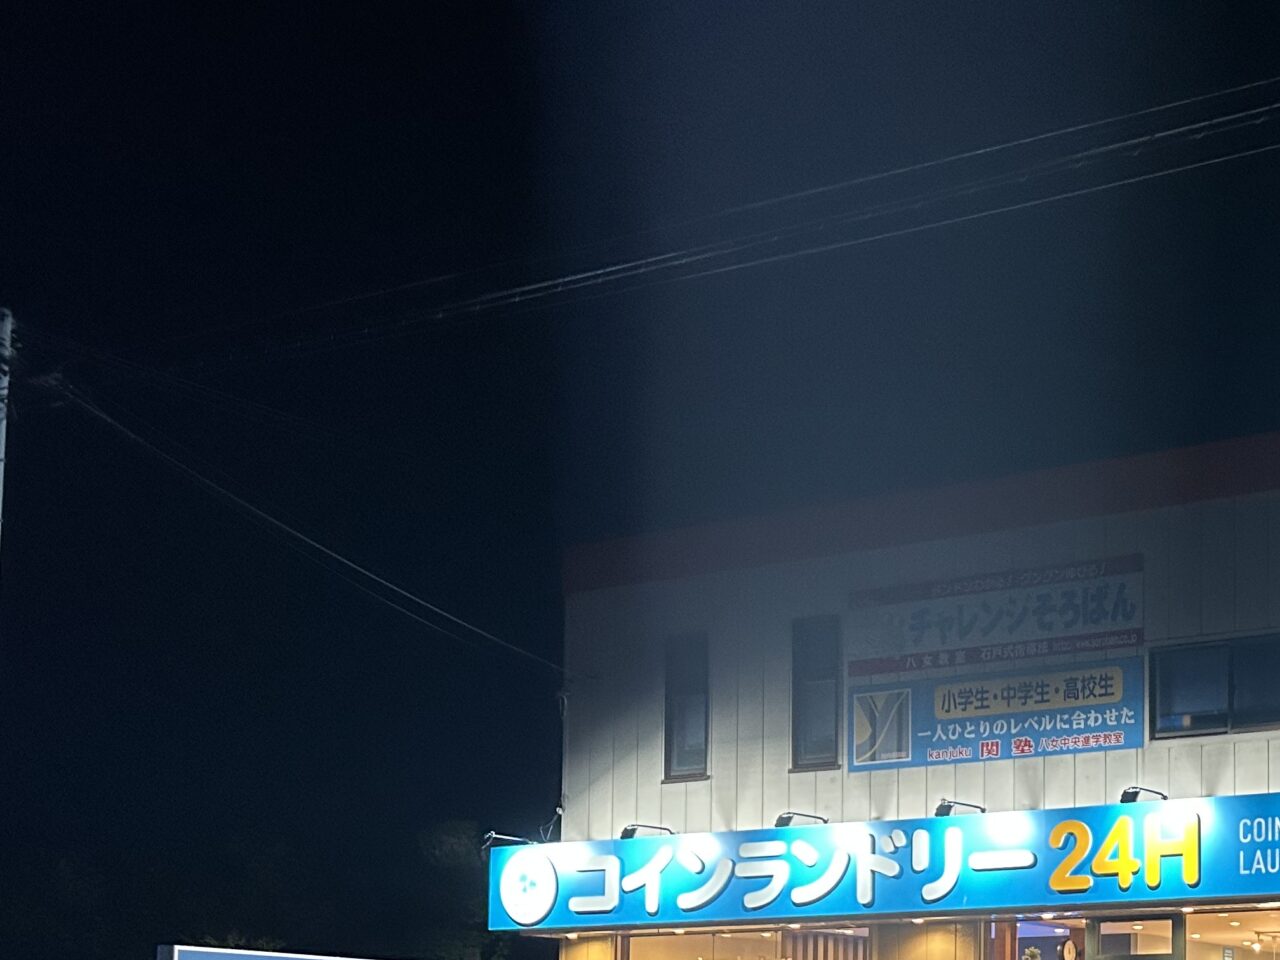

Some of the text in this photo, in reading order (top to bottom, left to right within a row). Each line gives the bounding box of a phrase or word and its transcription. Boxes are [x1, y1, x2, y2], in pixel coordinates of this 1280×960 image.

[908, 581, 1136, 645] チャレンジそろばん
[941, 674, 1115, 713] 小学生・中学生・高校生
[917, 707, 1135, 742] 一人ひとりのレベルに合わせた
[928, 747, 972, 761] kanjuku
[1038, 731, 1124, 752] 八女中央進学教室
[567, 812, 1201, 915] コインランドリー 24H
